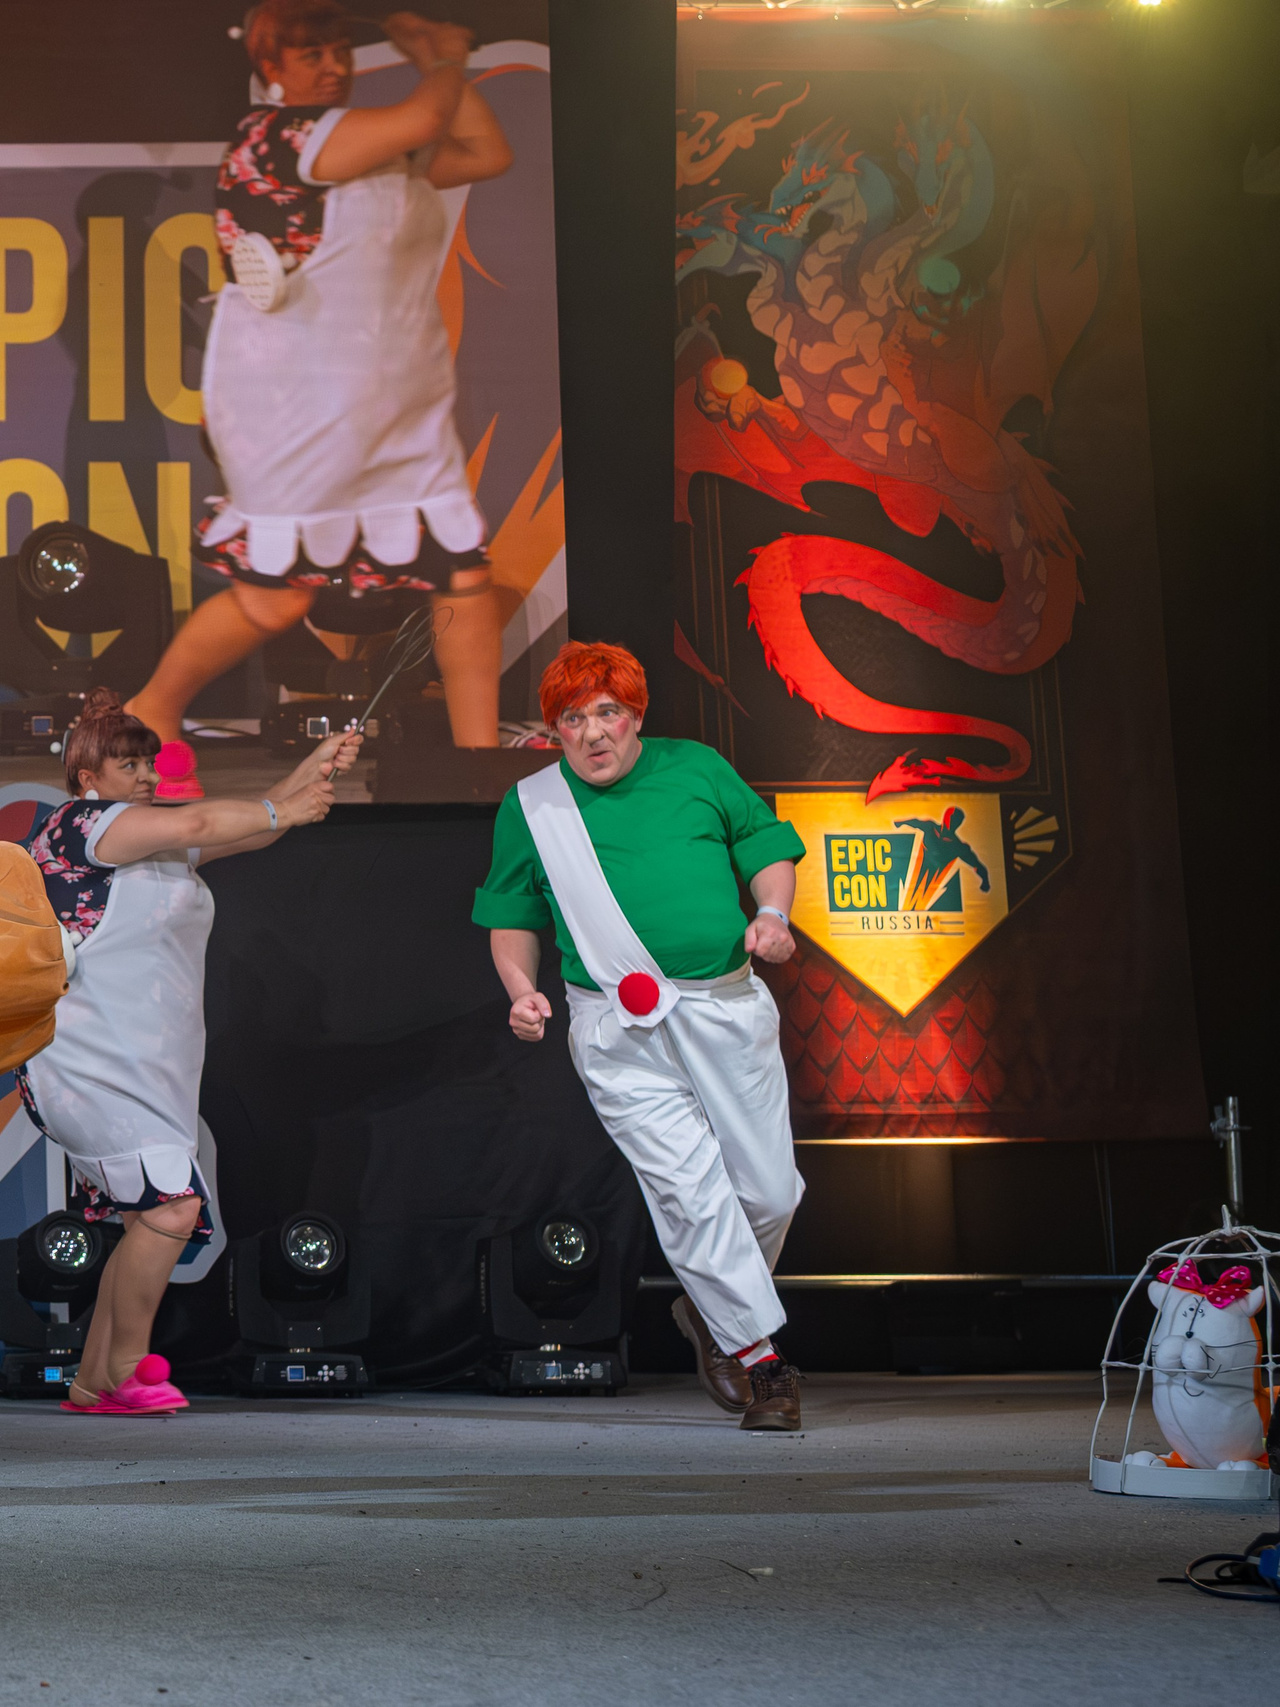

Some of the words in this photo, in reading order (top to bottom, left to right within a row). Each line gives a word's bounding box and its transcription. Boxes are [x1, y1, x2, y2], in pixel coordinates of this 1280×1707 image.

[830, 838, 893, 873] EPIC
[833, 874, 888, 909] CON
[861, 914, 934, 931] RUSSIA
